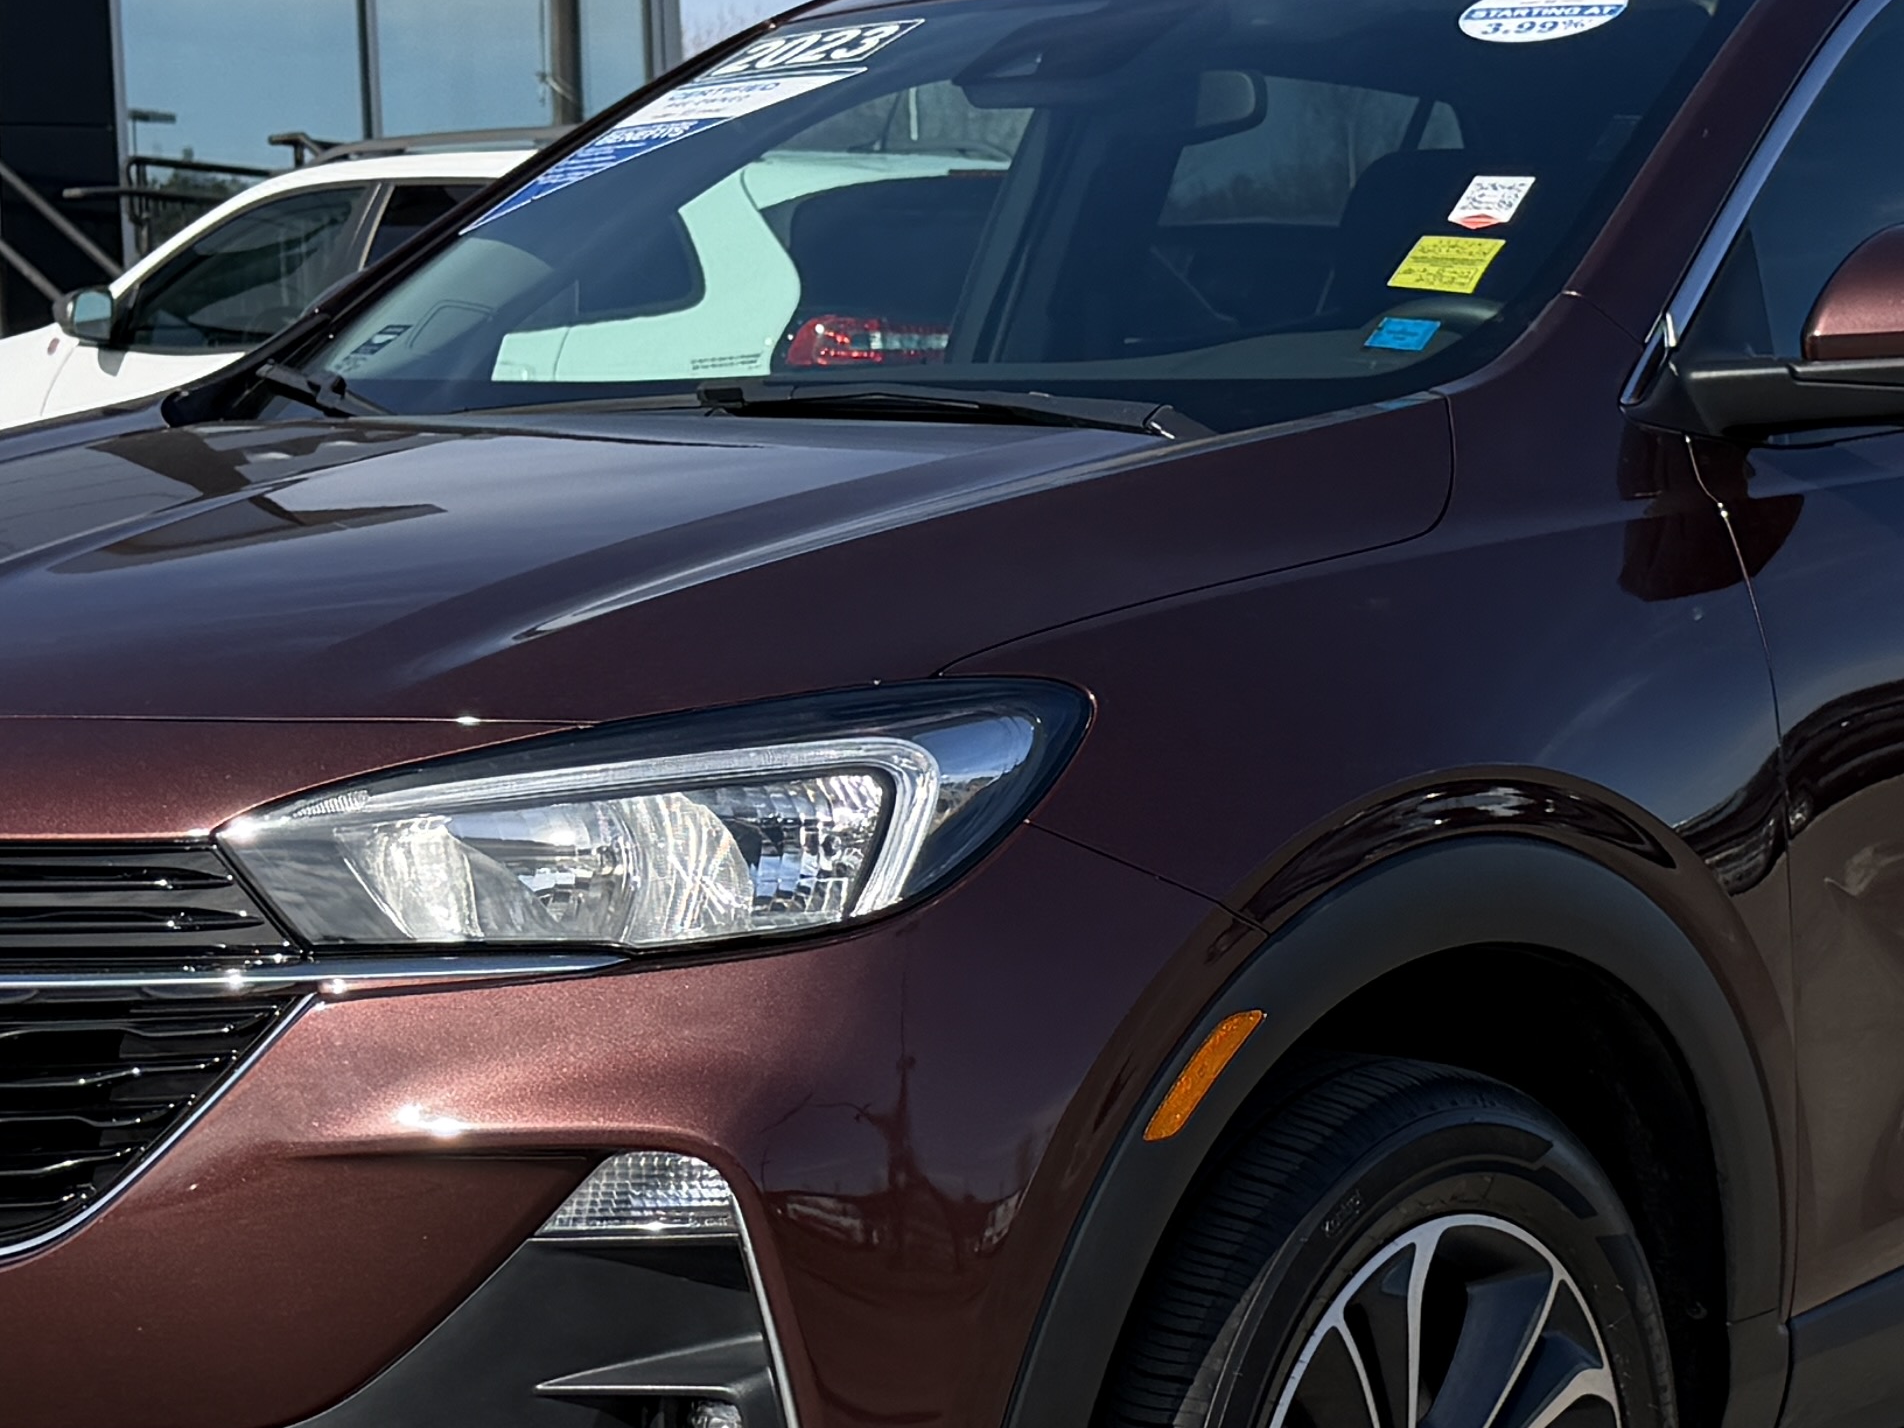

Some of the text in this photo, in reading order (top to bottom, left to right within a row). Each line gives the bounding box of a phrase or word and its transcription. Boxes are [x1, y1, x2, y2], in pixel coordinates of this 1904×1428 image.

[1471, 6, 1618, 19] STARTING AT
[710, 24, 900, 76] 2023
